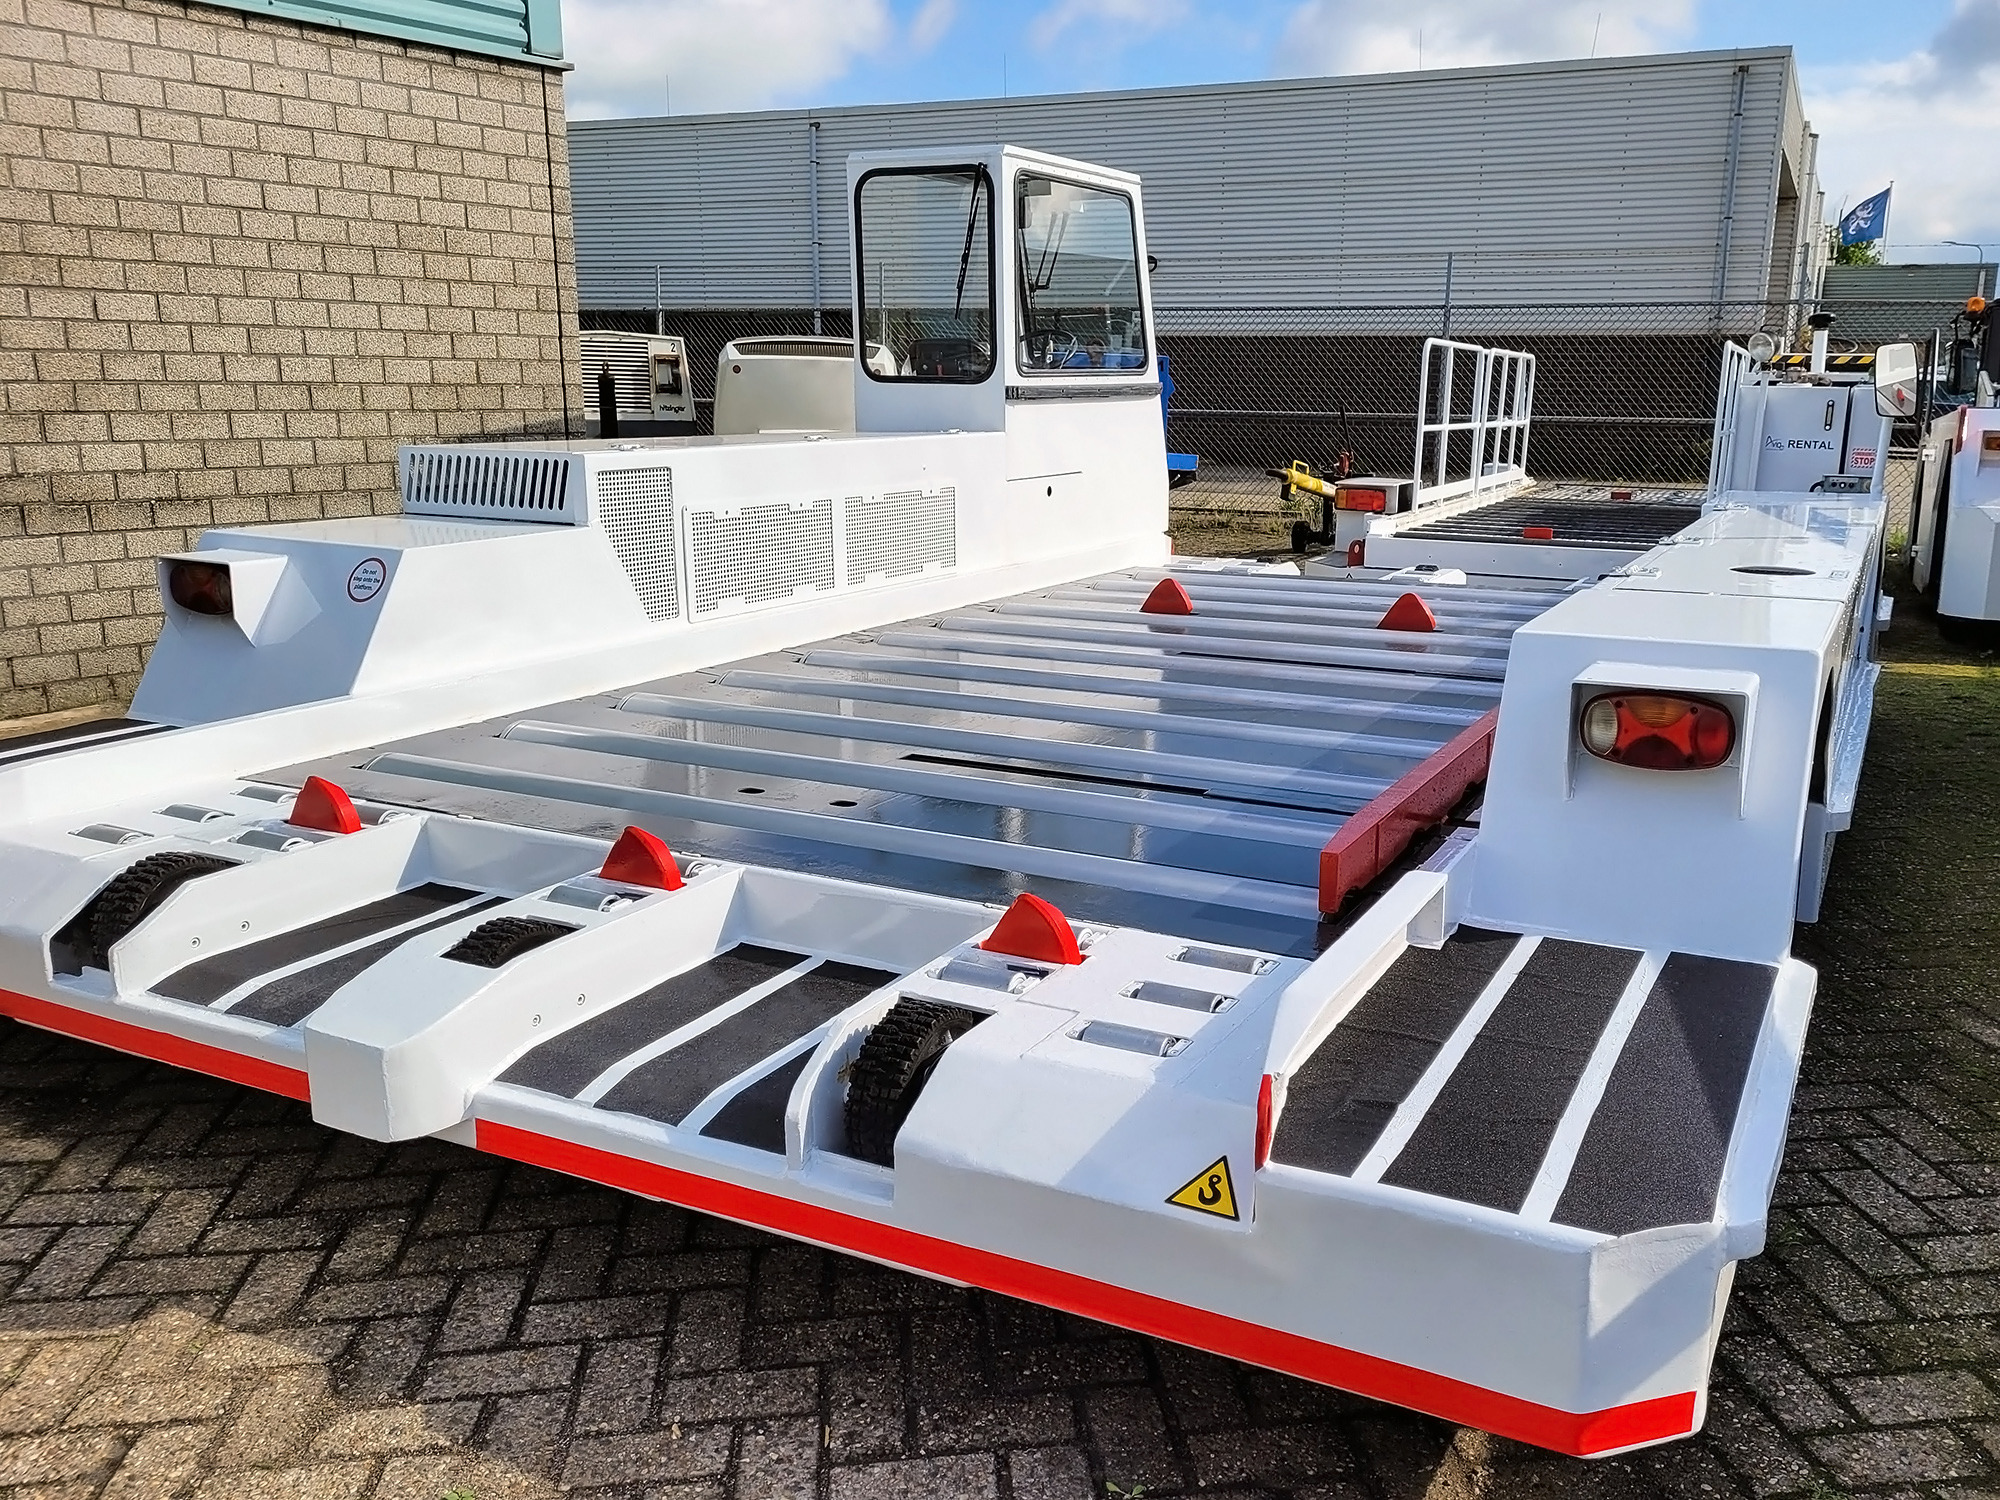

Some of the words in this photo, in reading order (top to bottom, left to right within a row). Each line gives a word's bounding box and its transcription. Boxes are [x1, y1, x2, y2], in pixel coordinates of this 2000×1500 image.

[670, 342, 676, 352] 2
[1787, 439, 1834, 450] RENTAL
[1853, 457, 1875, 465] STOP
